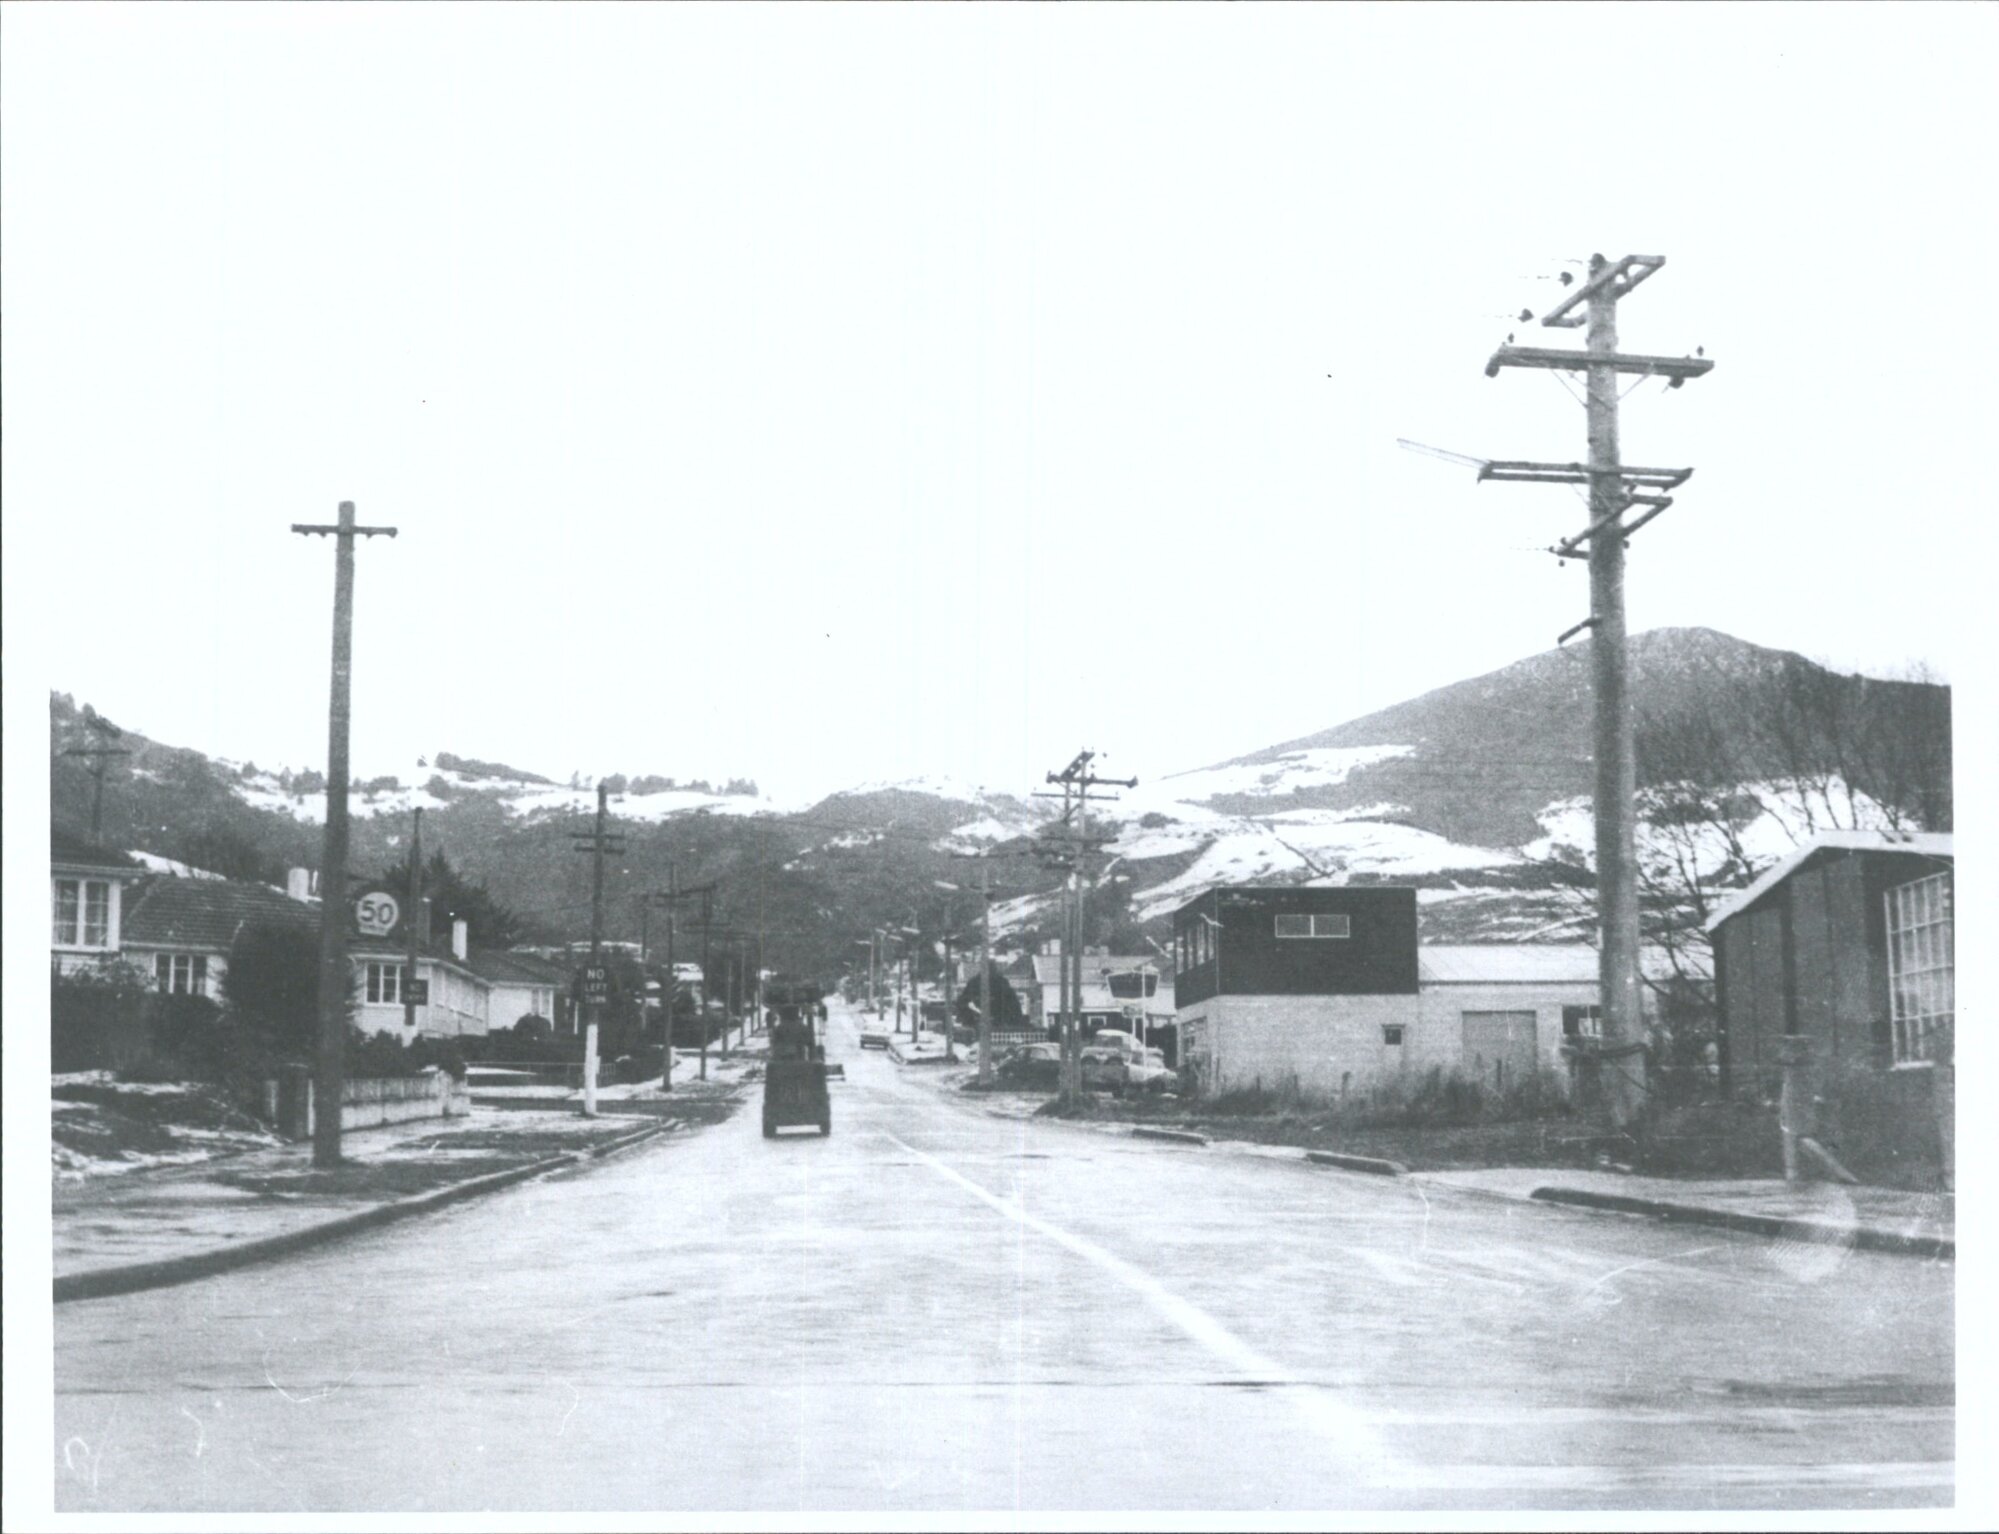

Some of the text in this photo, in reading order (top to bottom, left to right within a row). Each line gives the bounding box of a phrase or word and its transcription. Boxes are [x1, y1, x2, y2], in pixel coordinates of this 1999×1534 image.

[361, 900, 394, 924] 50
[587, 969, 605, 980] NO
[584, 982, 607, 992] LEFT
